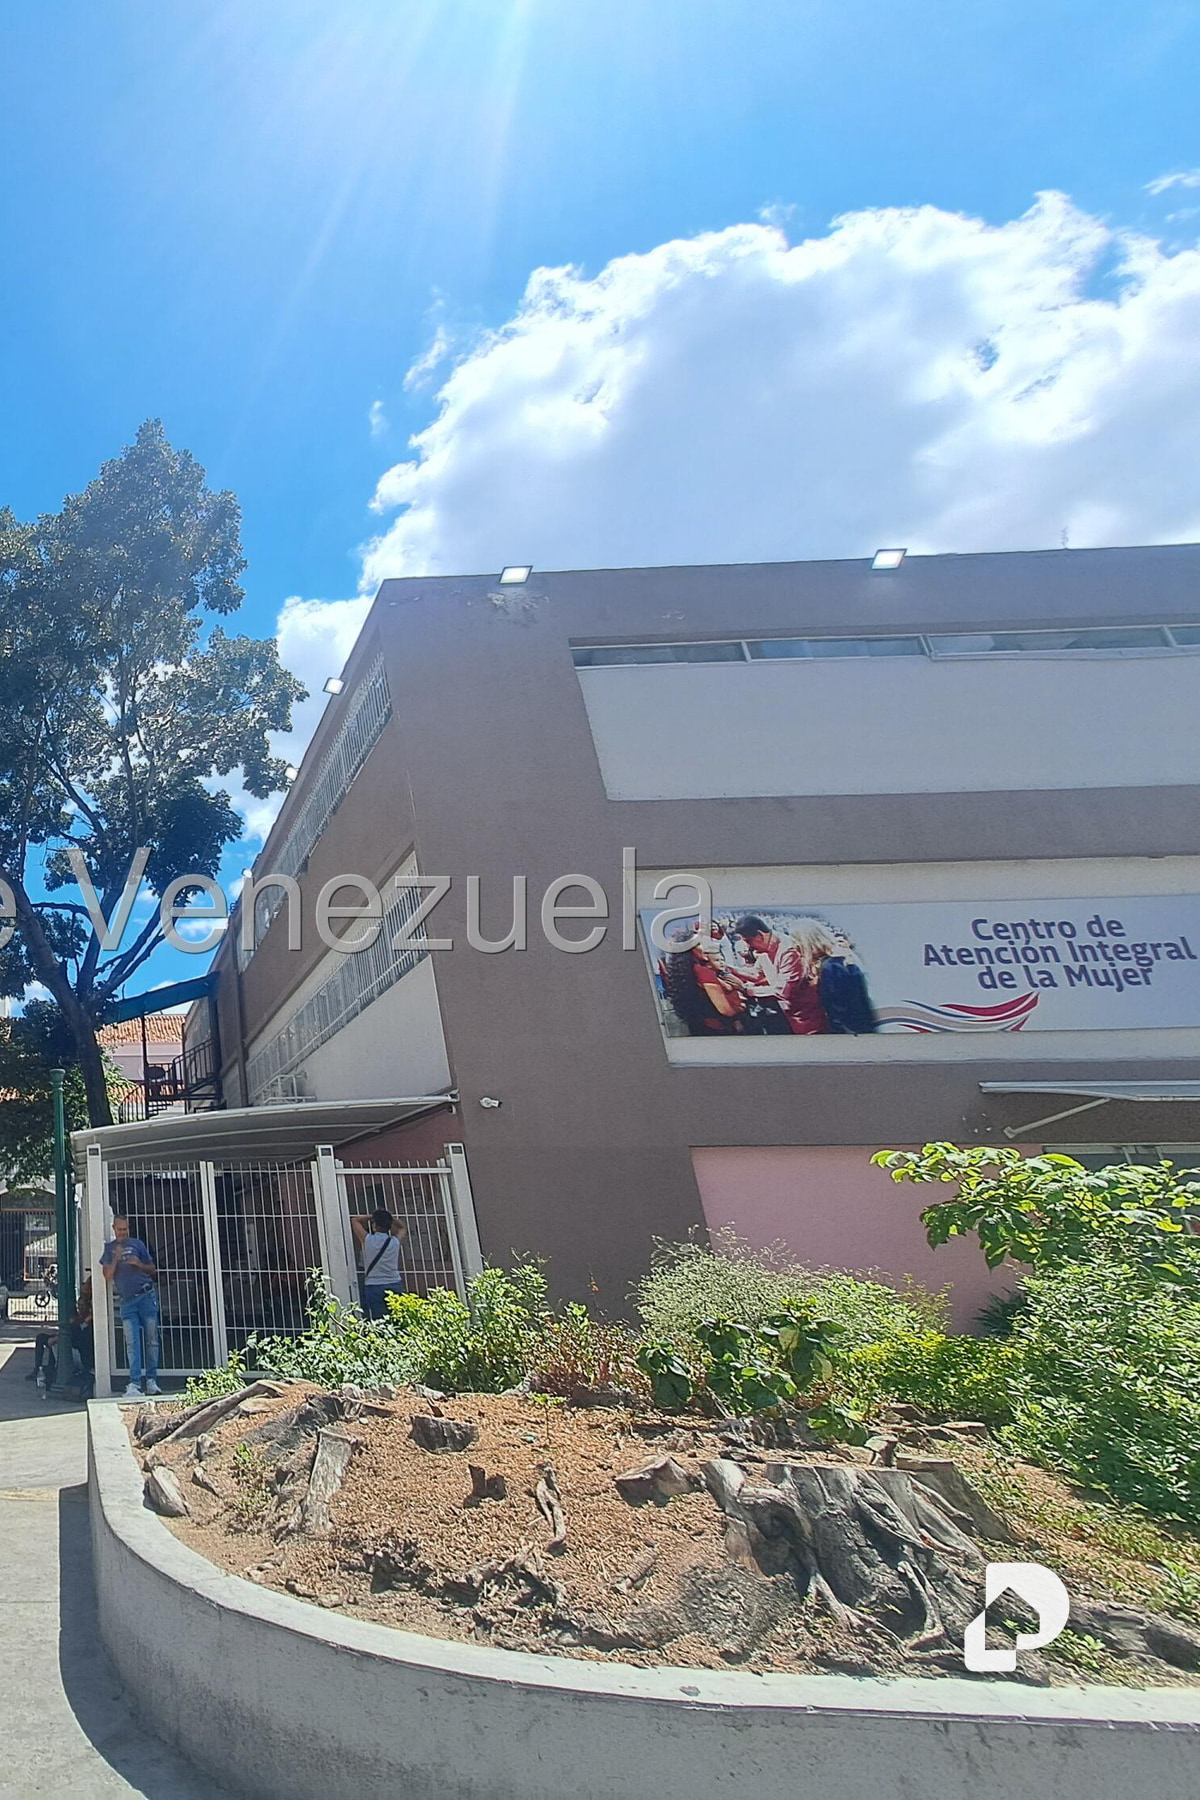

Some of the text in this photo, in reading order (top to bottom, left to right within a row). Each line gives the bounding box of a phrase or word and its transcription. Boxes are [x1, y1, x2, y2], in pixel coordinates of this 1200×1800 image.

[971, 915, 1126, 941] Centro de
[924, 936, 1198, 967] Atención Integral
[977, 962, 1153, 992] de la Mujer
